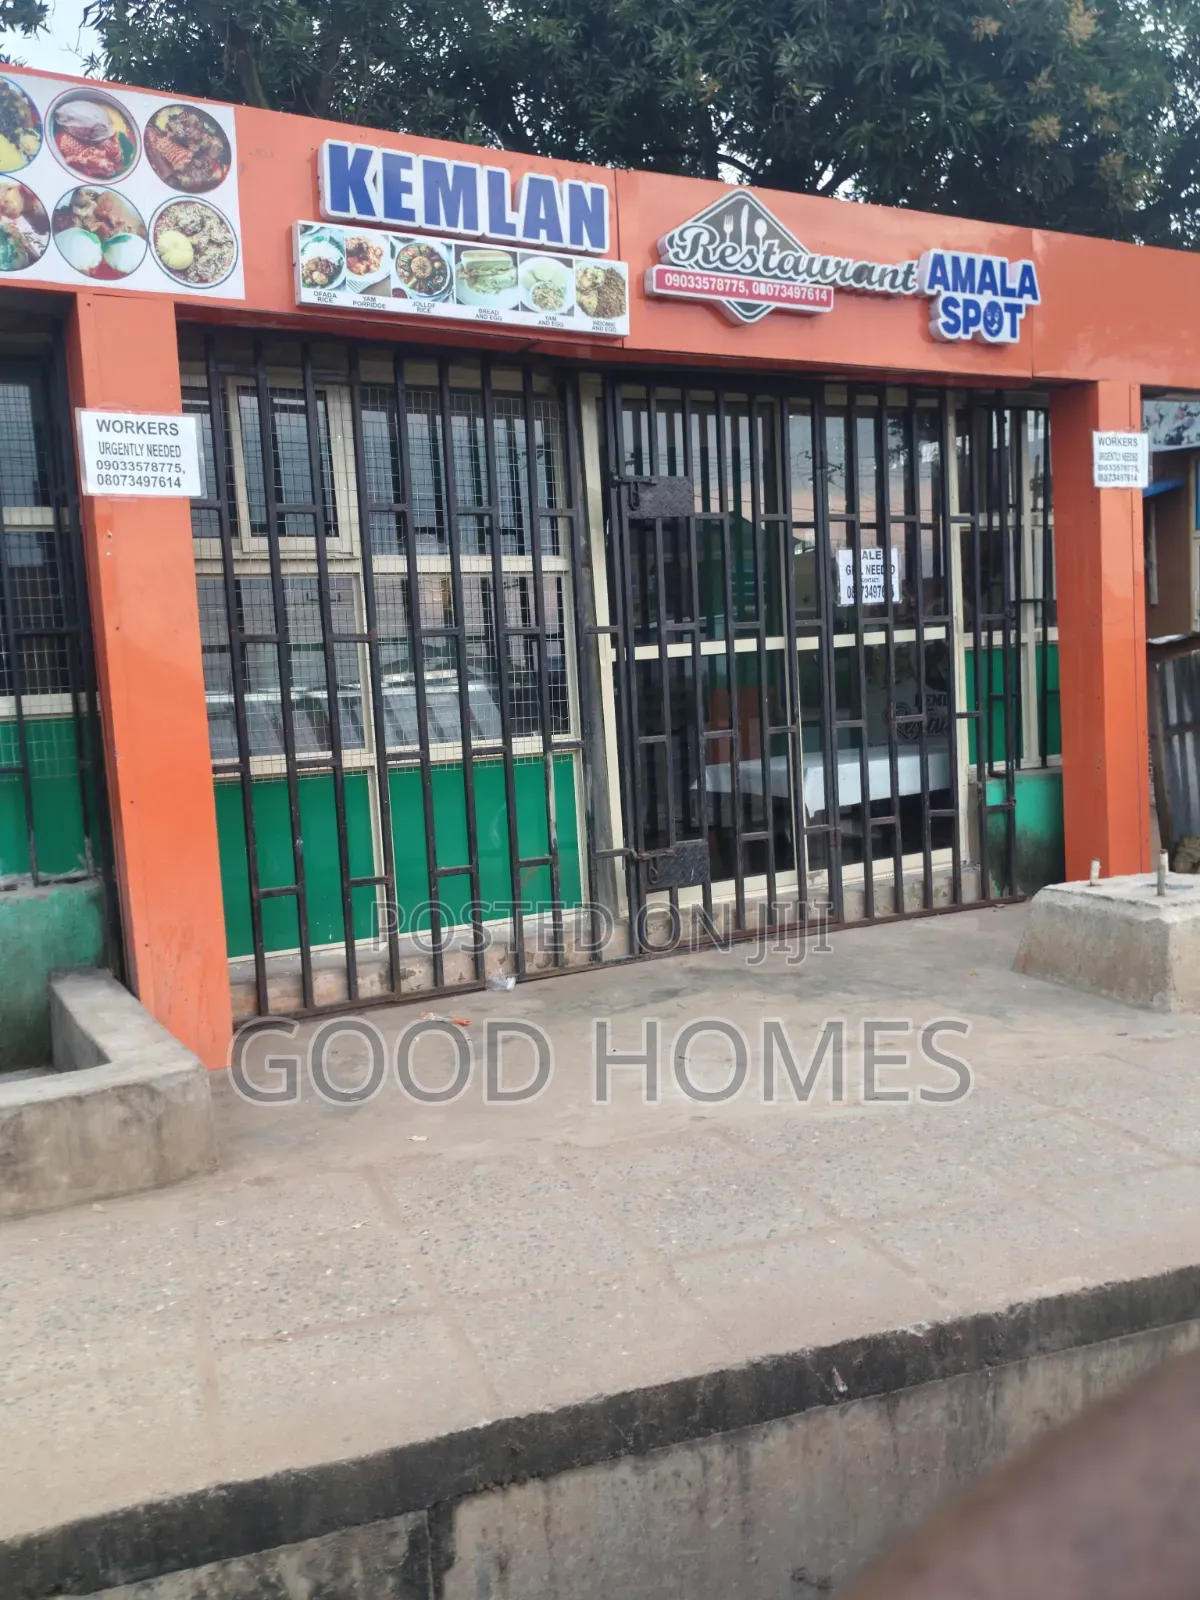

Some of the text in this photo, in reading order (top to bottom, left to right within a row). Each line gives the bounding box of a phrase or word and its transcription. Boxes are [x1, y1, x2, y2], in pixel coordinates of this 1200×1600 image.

[327, 143, 606, 250] KEMLAN
[669, 223, 918, 294] Restaurant
[664, 272, 749, 296] 09033578775,
[927, 252, 1039, 301] AMALA
[313, 290, 337, 299] OFADA
[317, 296, 334, 304] RICE
[352, 300, 387, 309] PORRIDGE
[478, 307, 500, 316] BREAD
[551, 320, 564, 328] EGG
[941, 296, 1023, 339] SPOT
[95, 418, 180, 437] WORKERS
[98, 441, 182, 459] URGENTLY NEEDED
[1097, 436, 1139, 448] WORKERS
[96, 459, 186, 475] 09033578775,
[96, 473, 182, 489] 08073497614
[865, 564, 896, 575] NEEDD
